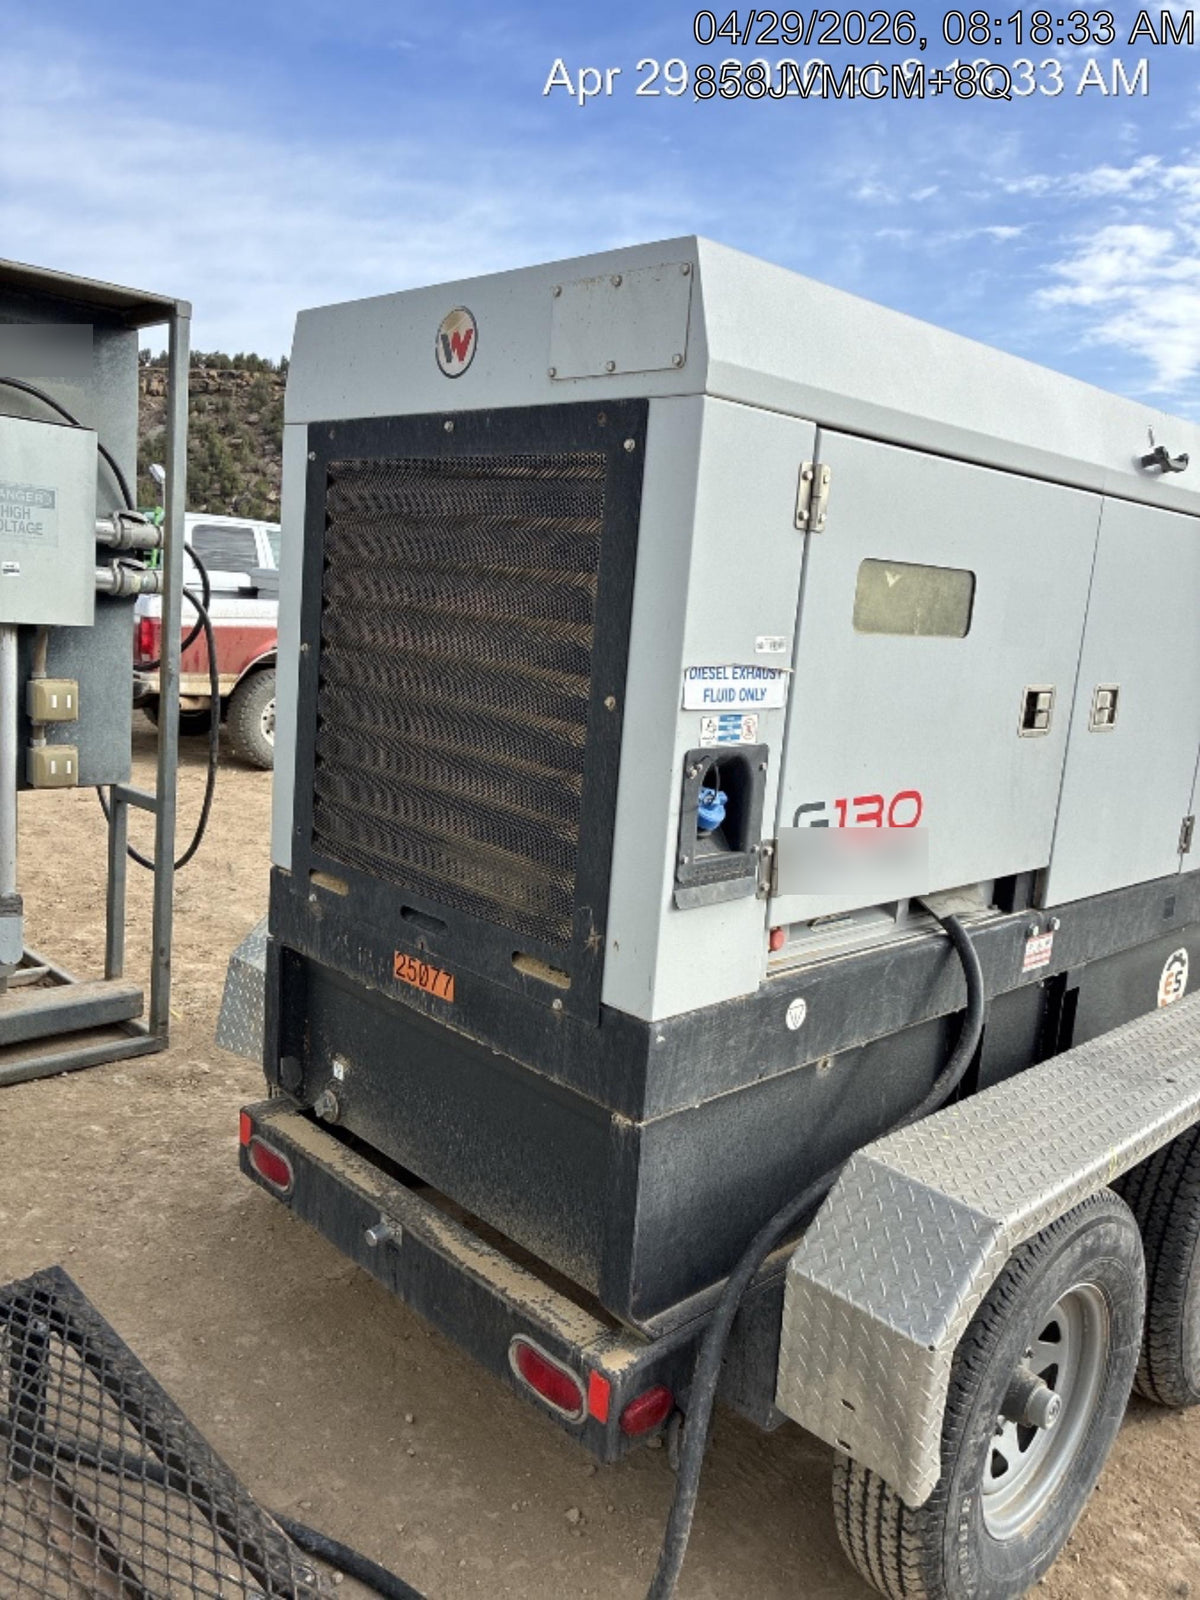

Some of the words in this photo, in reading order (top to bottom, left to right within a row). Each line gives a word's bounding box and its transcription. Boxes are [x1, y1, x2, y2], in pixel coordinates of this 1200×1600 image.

[0, 504, 31, 519] HIGH
[689, 666, 729, 680] DIESEL
[703, 688, 737, 703] FLUID
[739, 688, 767, 702] ONLY
[396, 952, 453, 997] 25077
